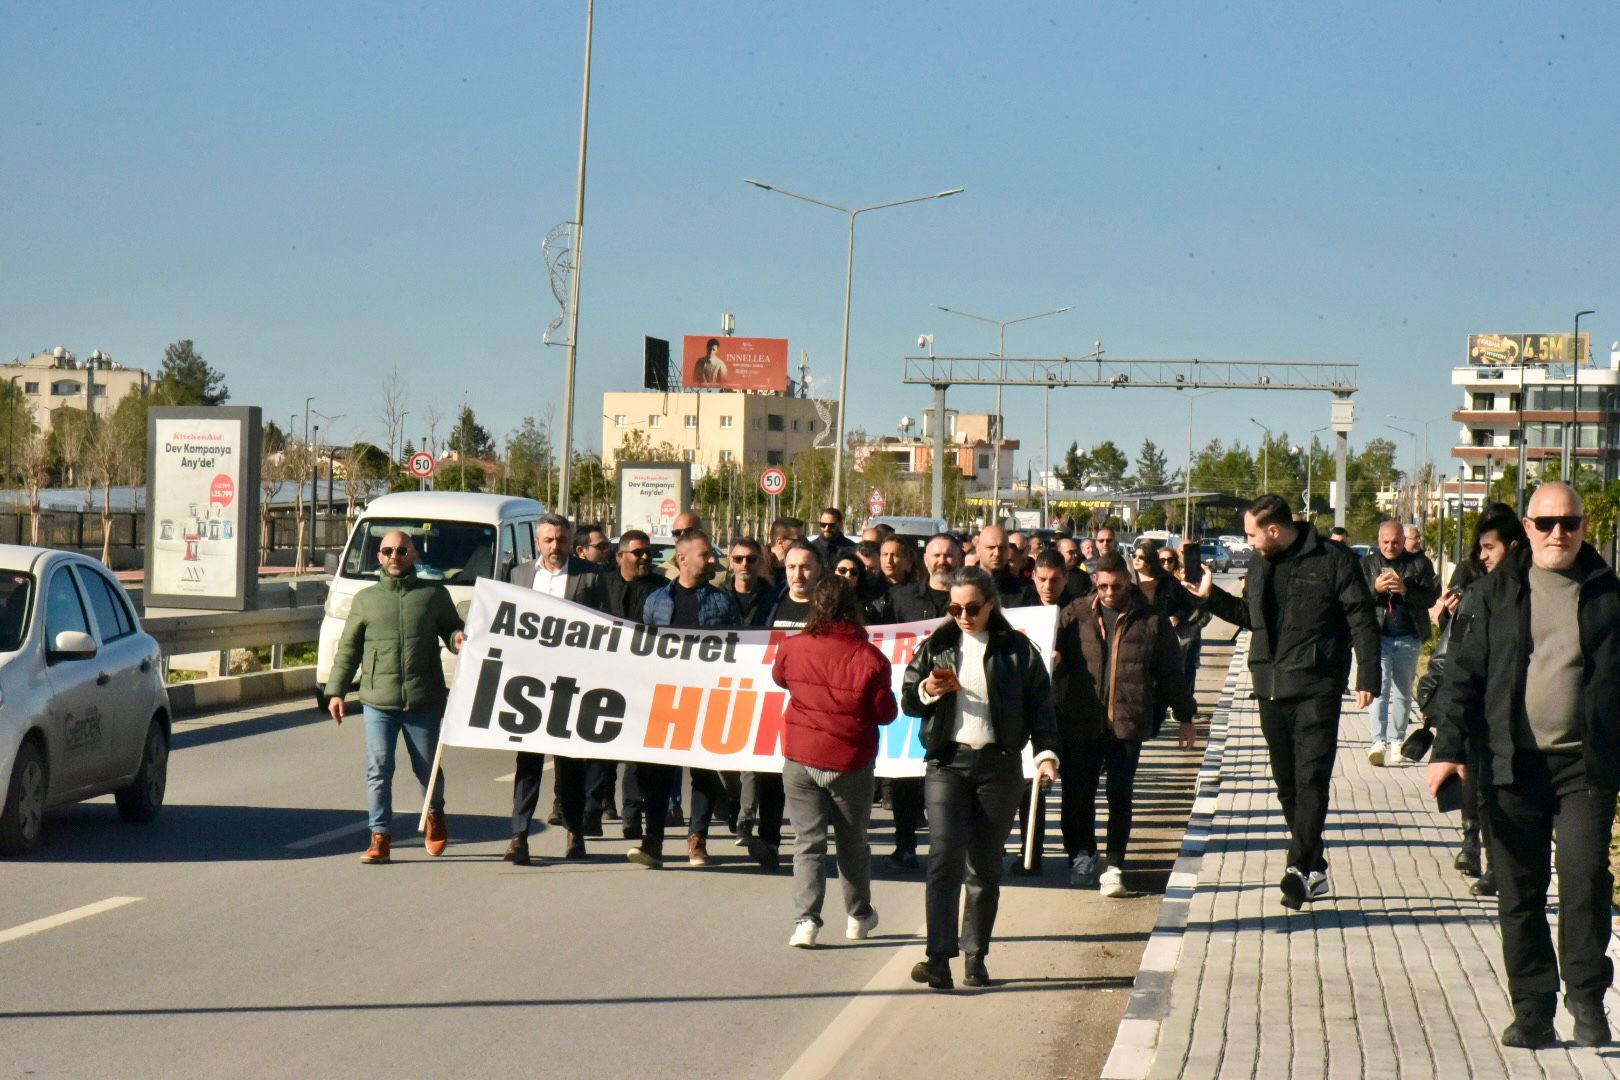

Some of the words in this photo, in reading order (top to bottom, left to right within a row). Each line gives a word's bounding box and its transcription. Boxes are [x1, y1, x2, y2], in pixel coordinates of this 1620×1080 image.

[726, 353, 771, 363] INNELLEA
[165, 443, 182, 453] Dev
[184, 443, 231, 456] Kampanya
[181, 457, 215, 469] Any'de!
[415, 459, 430, 470] 50
[766, 475, 781, 487] 50
[489, 600, 624, 653] Asgari
[468, 646, 627, 743] İşte
